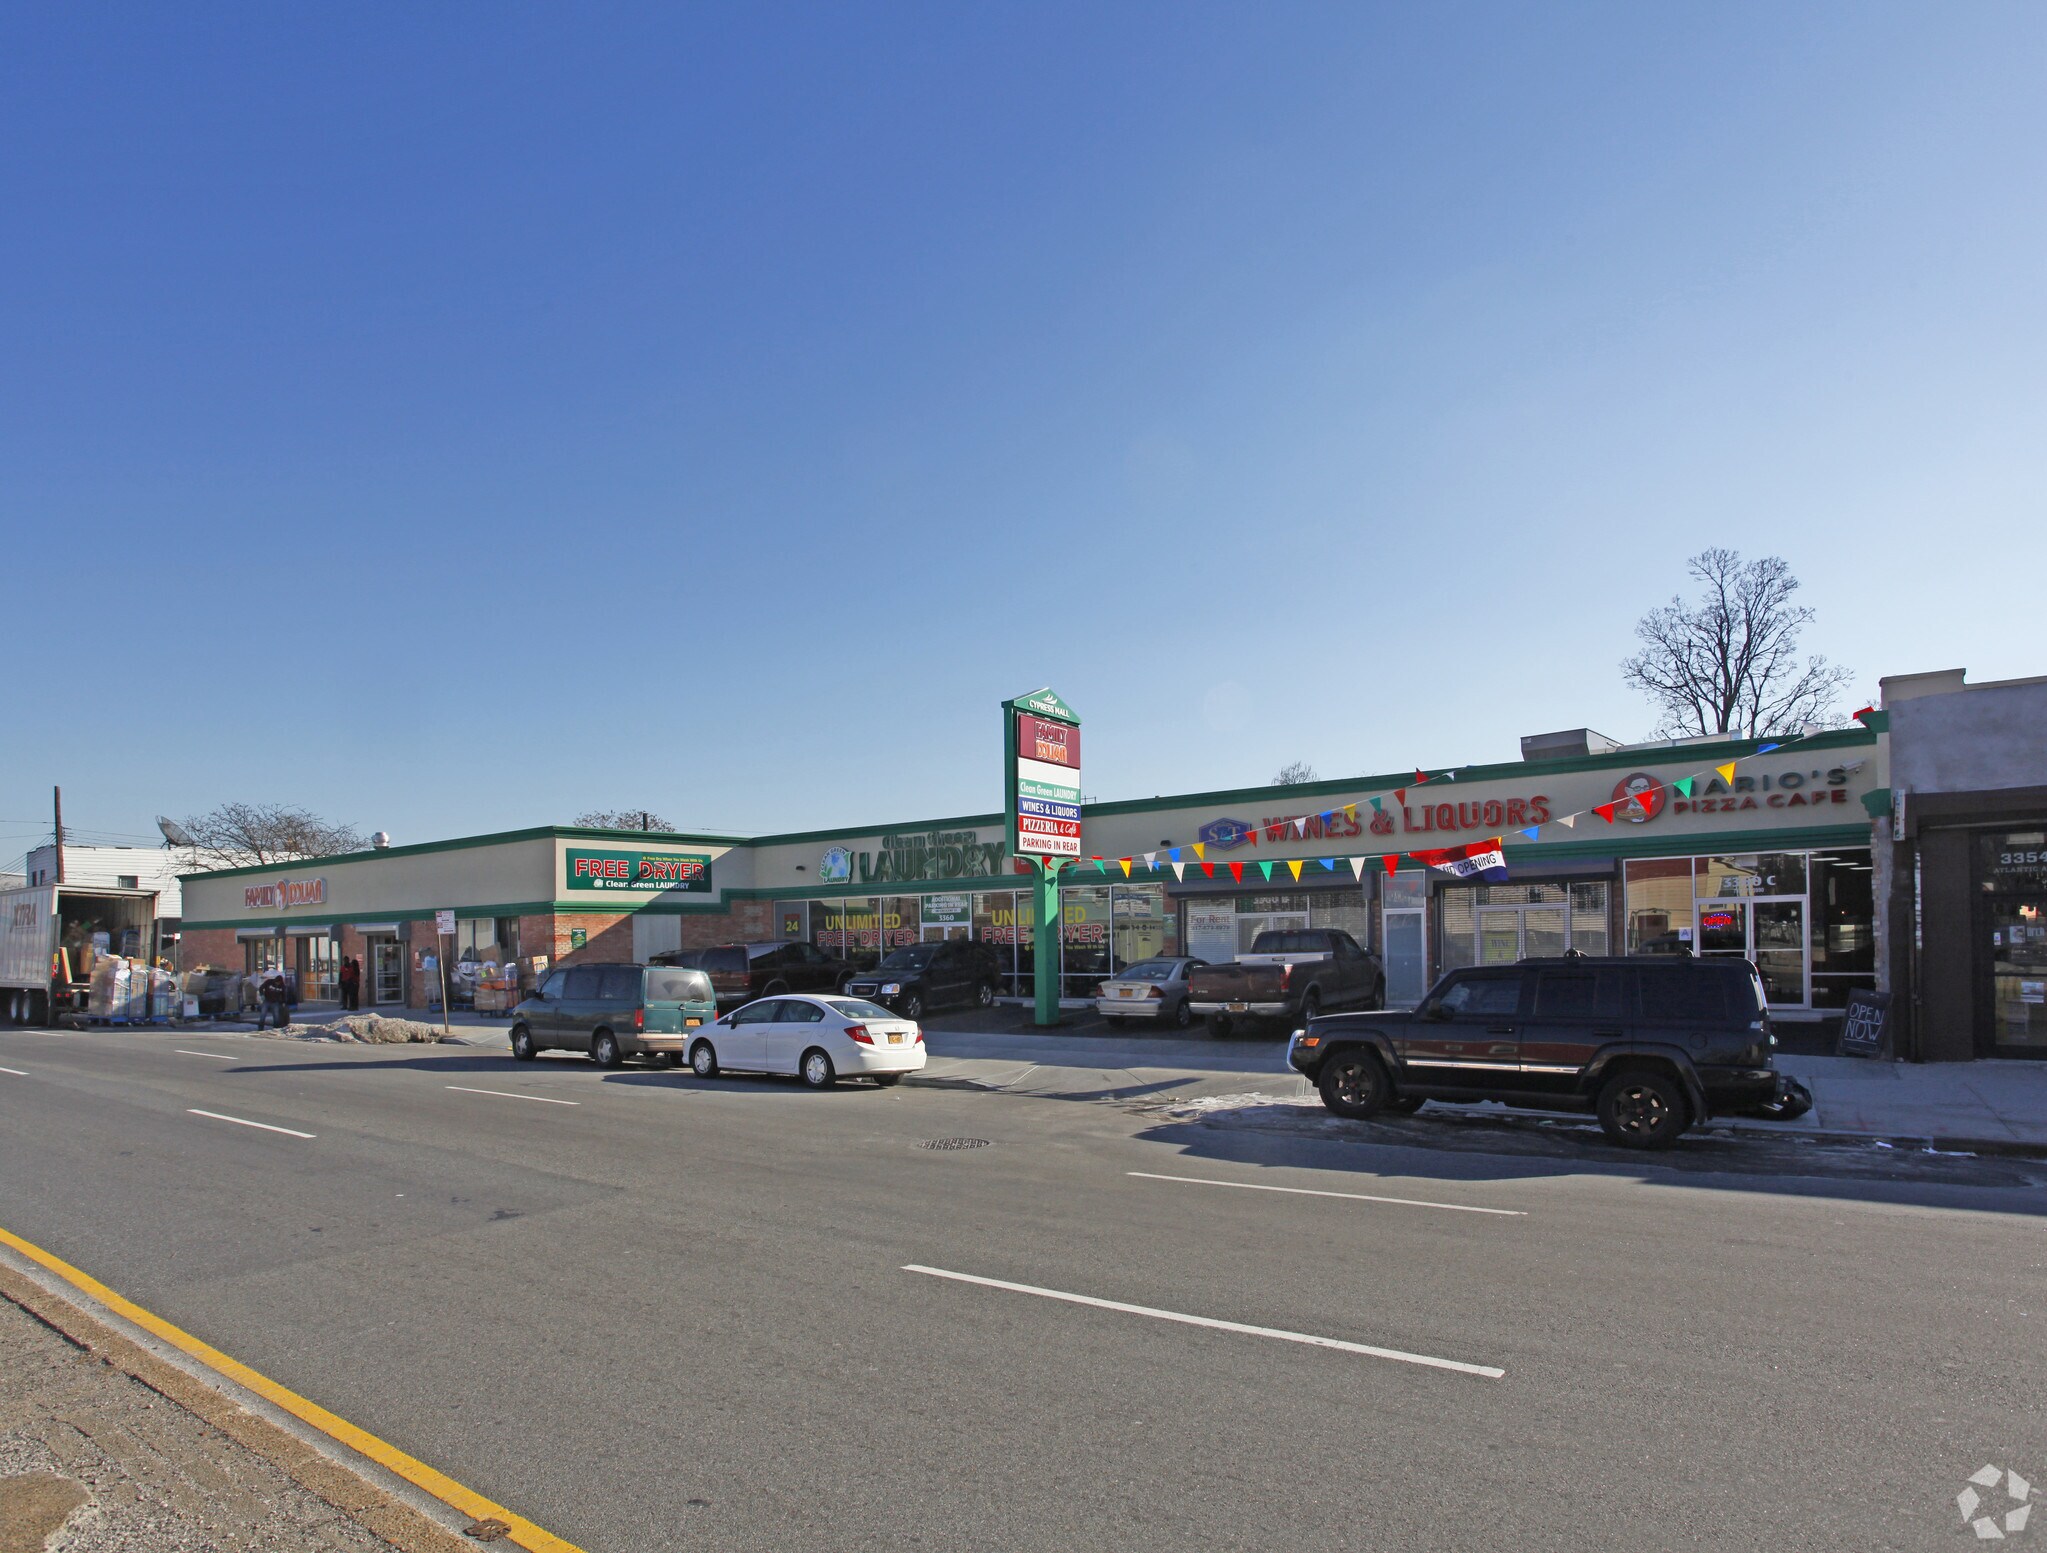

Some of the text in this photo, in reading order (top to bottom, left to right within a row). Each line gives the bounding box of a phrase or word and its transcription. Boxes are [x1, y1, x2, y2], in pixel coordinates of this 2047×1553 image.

[1029, 699, 1070, 718] CYPRESS MALL
[1035, 721, 1068, 745] FAMILY
[1035, 739, 1068, 763] DOLLAR
[1020, 781, 1077, 800] Clean Green LAUNDRY
[1022, 800, 1078, 818] WINES & LIQUORS
[1674, 788, 1848, 815] PIZZA CAFE
[1023, 818, 1058, 834] PIZZERIA
[1262, 795, 1552, 842] WINES & LIQUORS
[1022, 837, 1078, 852] PARKING IN REAR
[858, 842, 1006, 884] LAUNDRY
[1458, 854, 1497, 874] OPENING
[2000, 851, 2047, 865] 3354
[575, 858, 705, 881] FREE DRYER
[1993, 865, 2039, 874] ATLANTIC
[605, 880, 690, 890] Clean Green LAUNDRY
[1766, 875, 1776, 886] C
[245, 884, 275, 909] FAMILY
[288, 878, 323, 906] DOLLAR
[10, 902, 37, 932] XTRA
[825, 913, 901, 930] UNLIMITED
[938, 914, 955, 922] 3360
[992, 906, 1087, 927] UNLIED
[1191, 914, 1230, 924] For Rent
[1703, 916, 1732, 925] OPEN
[786, 921, 799, 932] 24
[981, 923, 1104, 944] FREE RYER
[817, 929, 916, 947] FREE DRYER
[1849, 1002, 1885, 1025] OPEN
[1845, 1020, 1882, 1041] NOW
